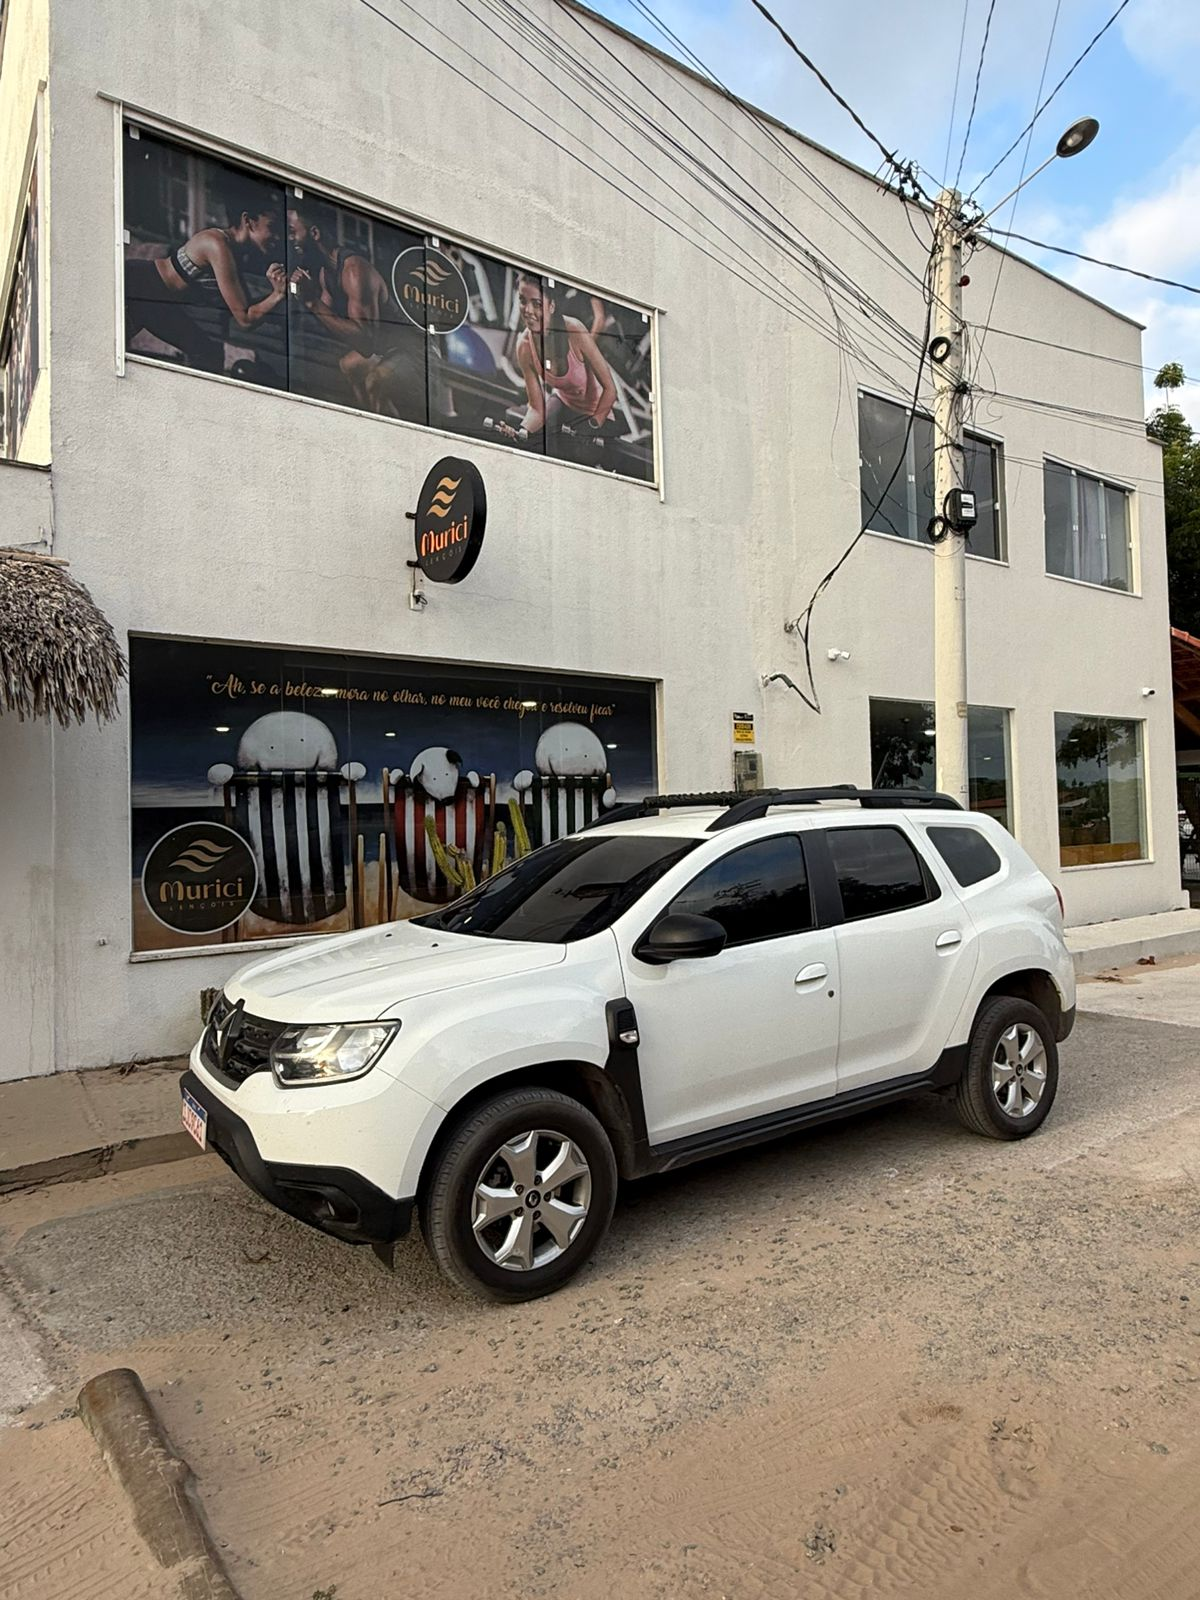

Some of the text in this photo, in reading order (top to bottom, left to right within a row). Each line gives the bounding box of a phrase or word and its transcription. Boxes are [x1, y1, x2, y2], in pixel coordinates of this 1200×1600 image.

[403, 283, 460, 314] Murici
[421, 514, 468, 557] Murici
[250, 680, 267, 695] se
[269, 684, 282, 695] a
[372, 690, 389, 702] no
[431, 694, 447, 705] no
[449, 696, 473, 707] meu
[476, 695, 501, 709] você
[549, 701, 588, 714] resolveu
[160, 877, 243, 902] Murici
